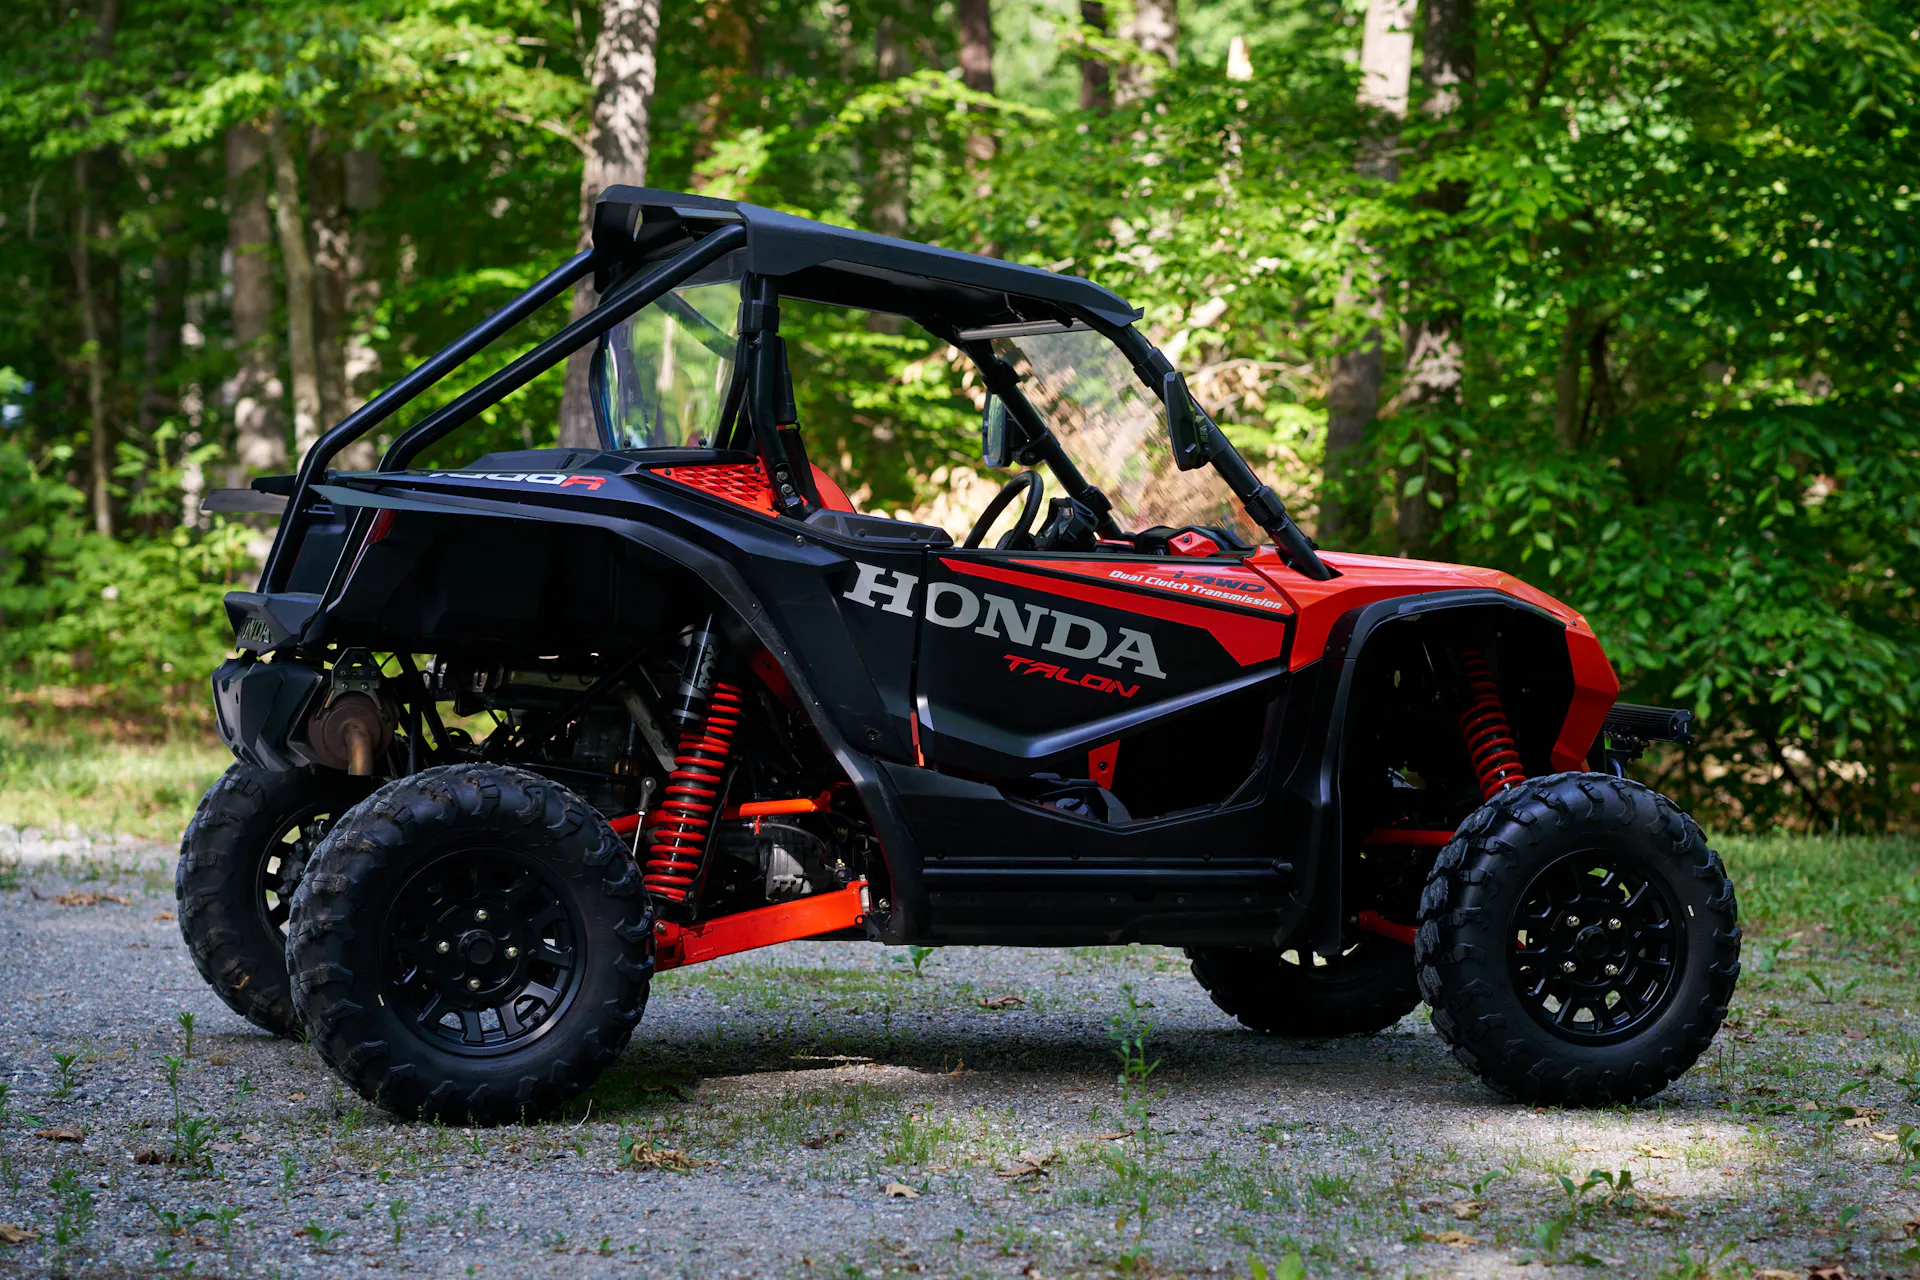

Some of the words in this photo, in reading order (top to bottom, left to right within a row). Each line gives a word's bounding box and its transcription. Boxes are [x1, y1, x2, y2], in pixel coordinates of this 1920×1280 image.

[1109, 570, 1142, 583] Dual
[1144, 577, 1190, 591] Clutch
[1191, 585, 1282, 609] Transmission
[1173, 571, 1266, 593] i-4WD
[843, 561, 1167, 679] HONDA
[1003, 654, 1141, 698] TALON
